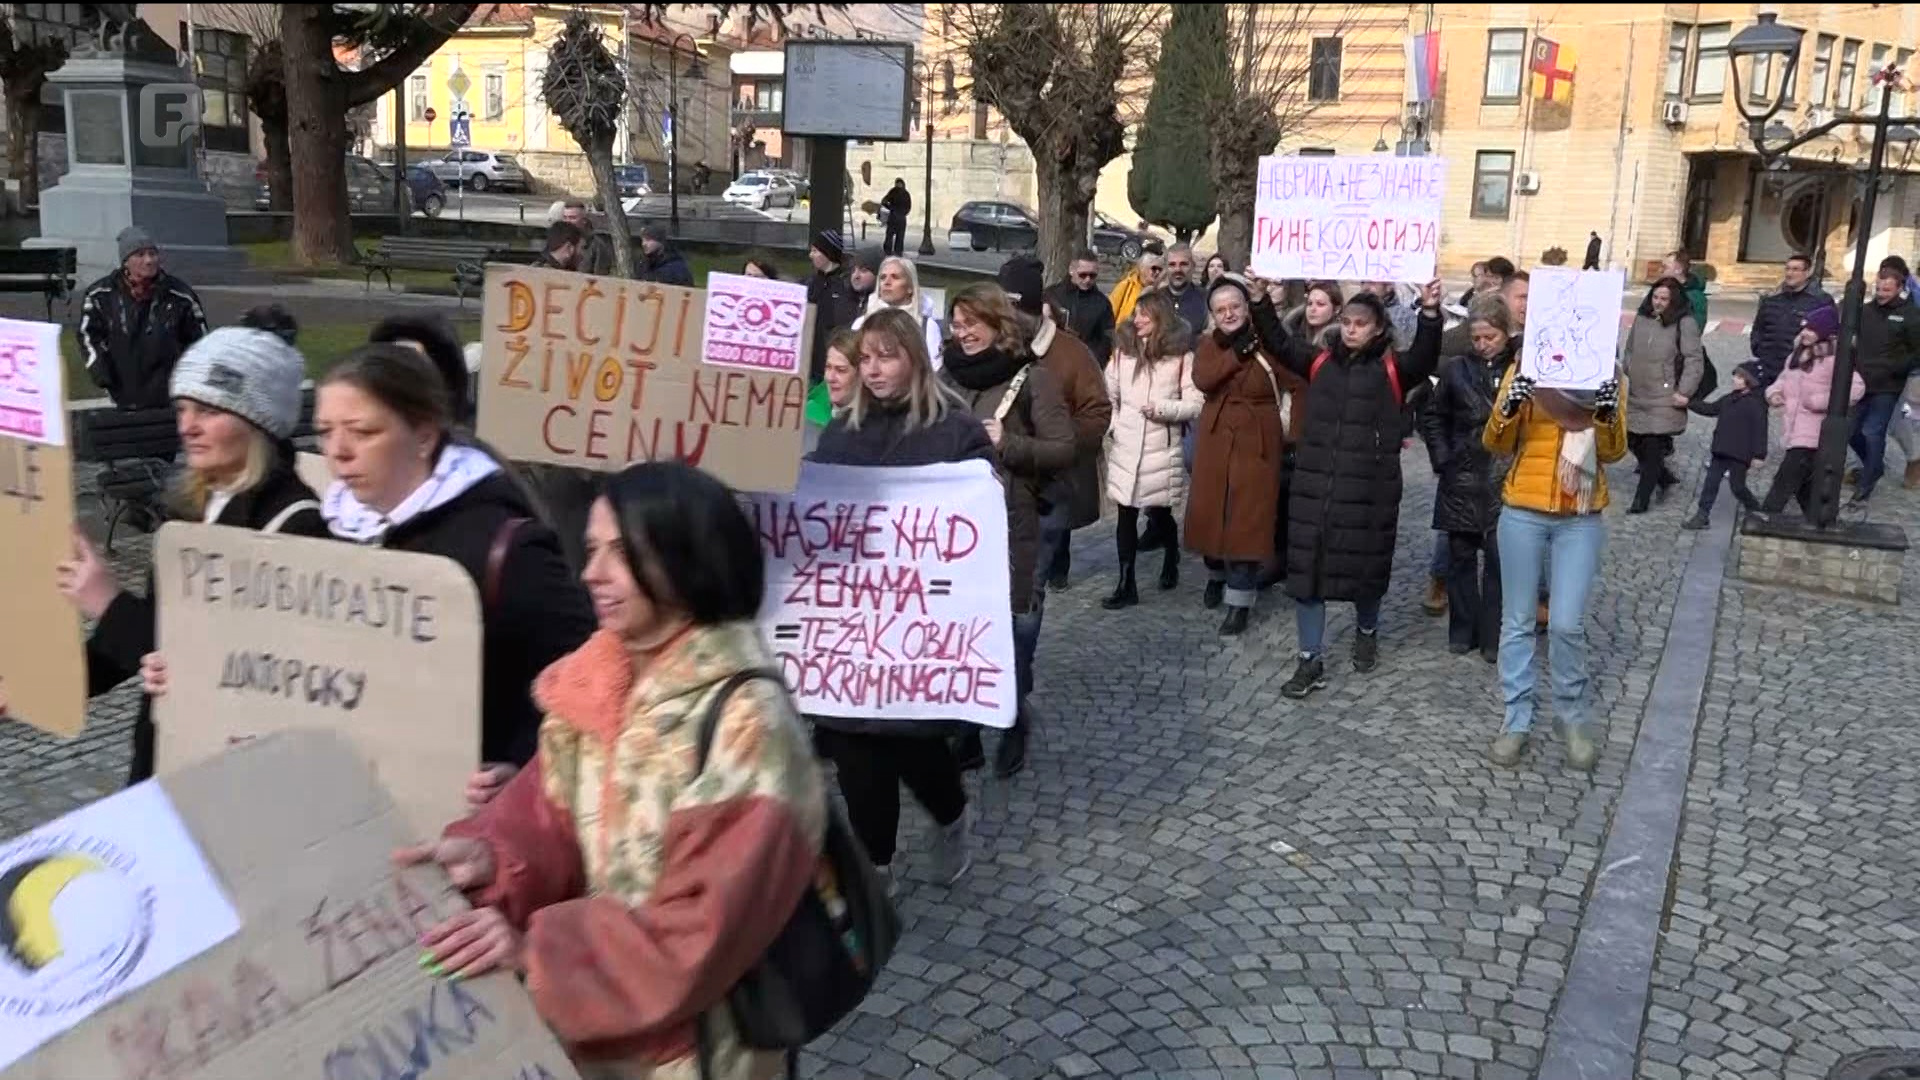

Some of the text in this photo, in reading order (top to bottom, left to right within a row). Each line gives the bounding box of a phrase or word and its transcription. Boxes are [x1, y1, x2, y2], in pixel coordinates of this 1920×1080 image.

[1256, 216, 1437, 255] ГИНЕКОЛОГИЈА
[709, 295, 801, 337] SOS
[499, 335, 805, 431] ŽIVOT NEMA
[542, 404, 710, 466] CENU
[891, 505, 979, 562] NAD
